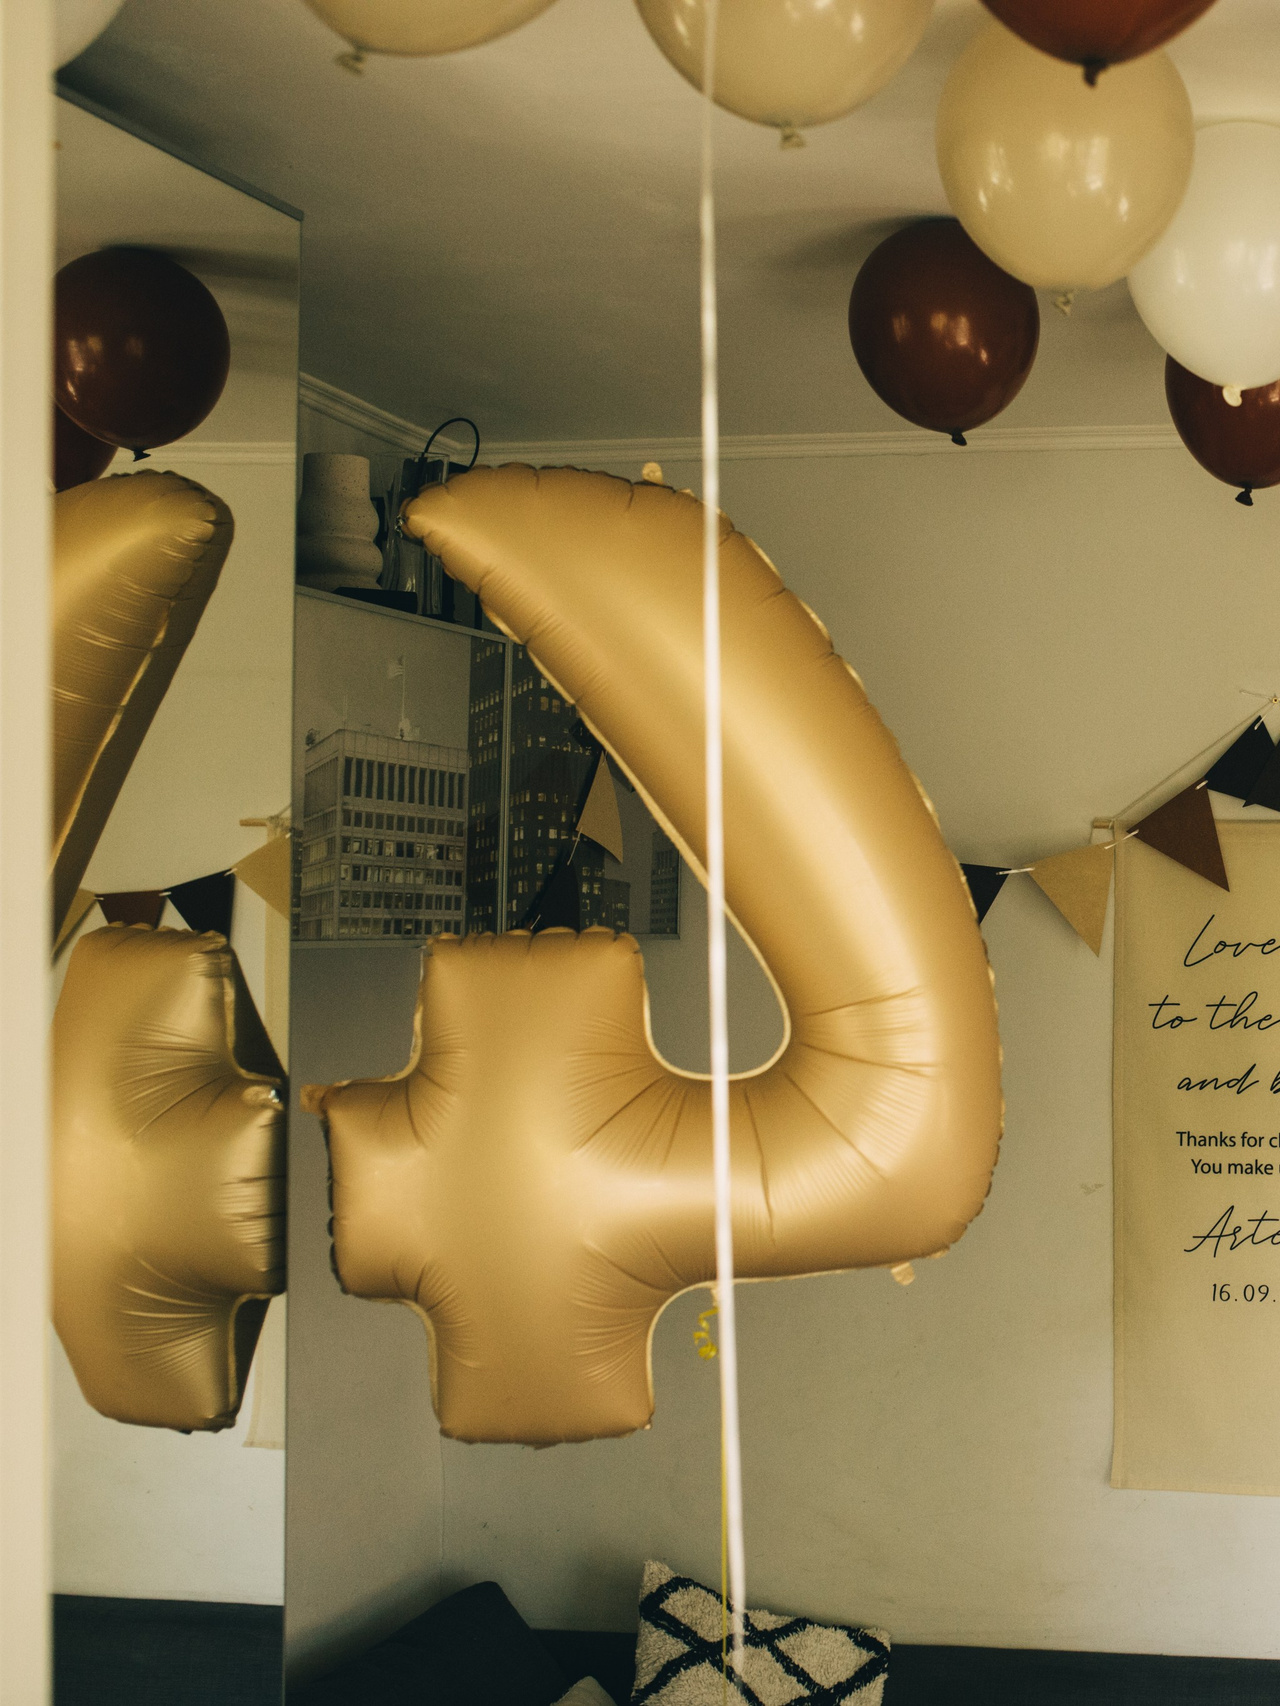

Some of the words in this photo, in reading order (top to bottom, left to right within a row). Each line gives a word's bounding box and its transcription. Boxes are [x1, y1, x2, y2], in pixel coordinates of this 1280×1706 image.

[1148, 994, 1198, 1030] to
[1176, 1063, 1260, 1096] and
[1175, 1130, 1237, 1149] Thanks
[1240, 1131, 1265, 1148] for
[1190, 1158, 1223, 1175] You
[1227, 1158, 1274, 1176] make
